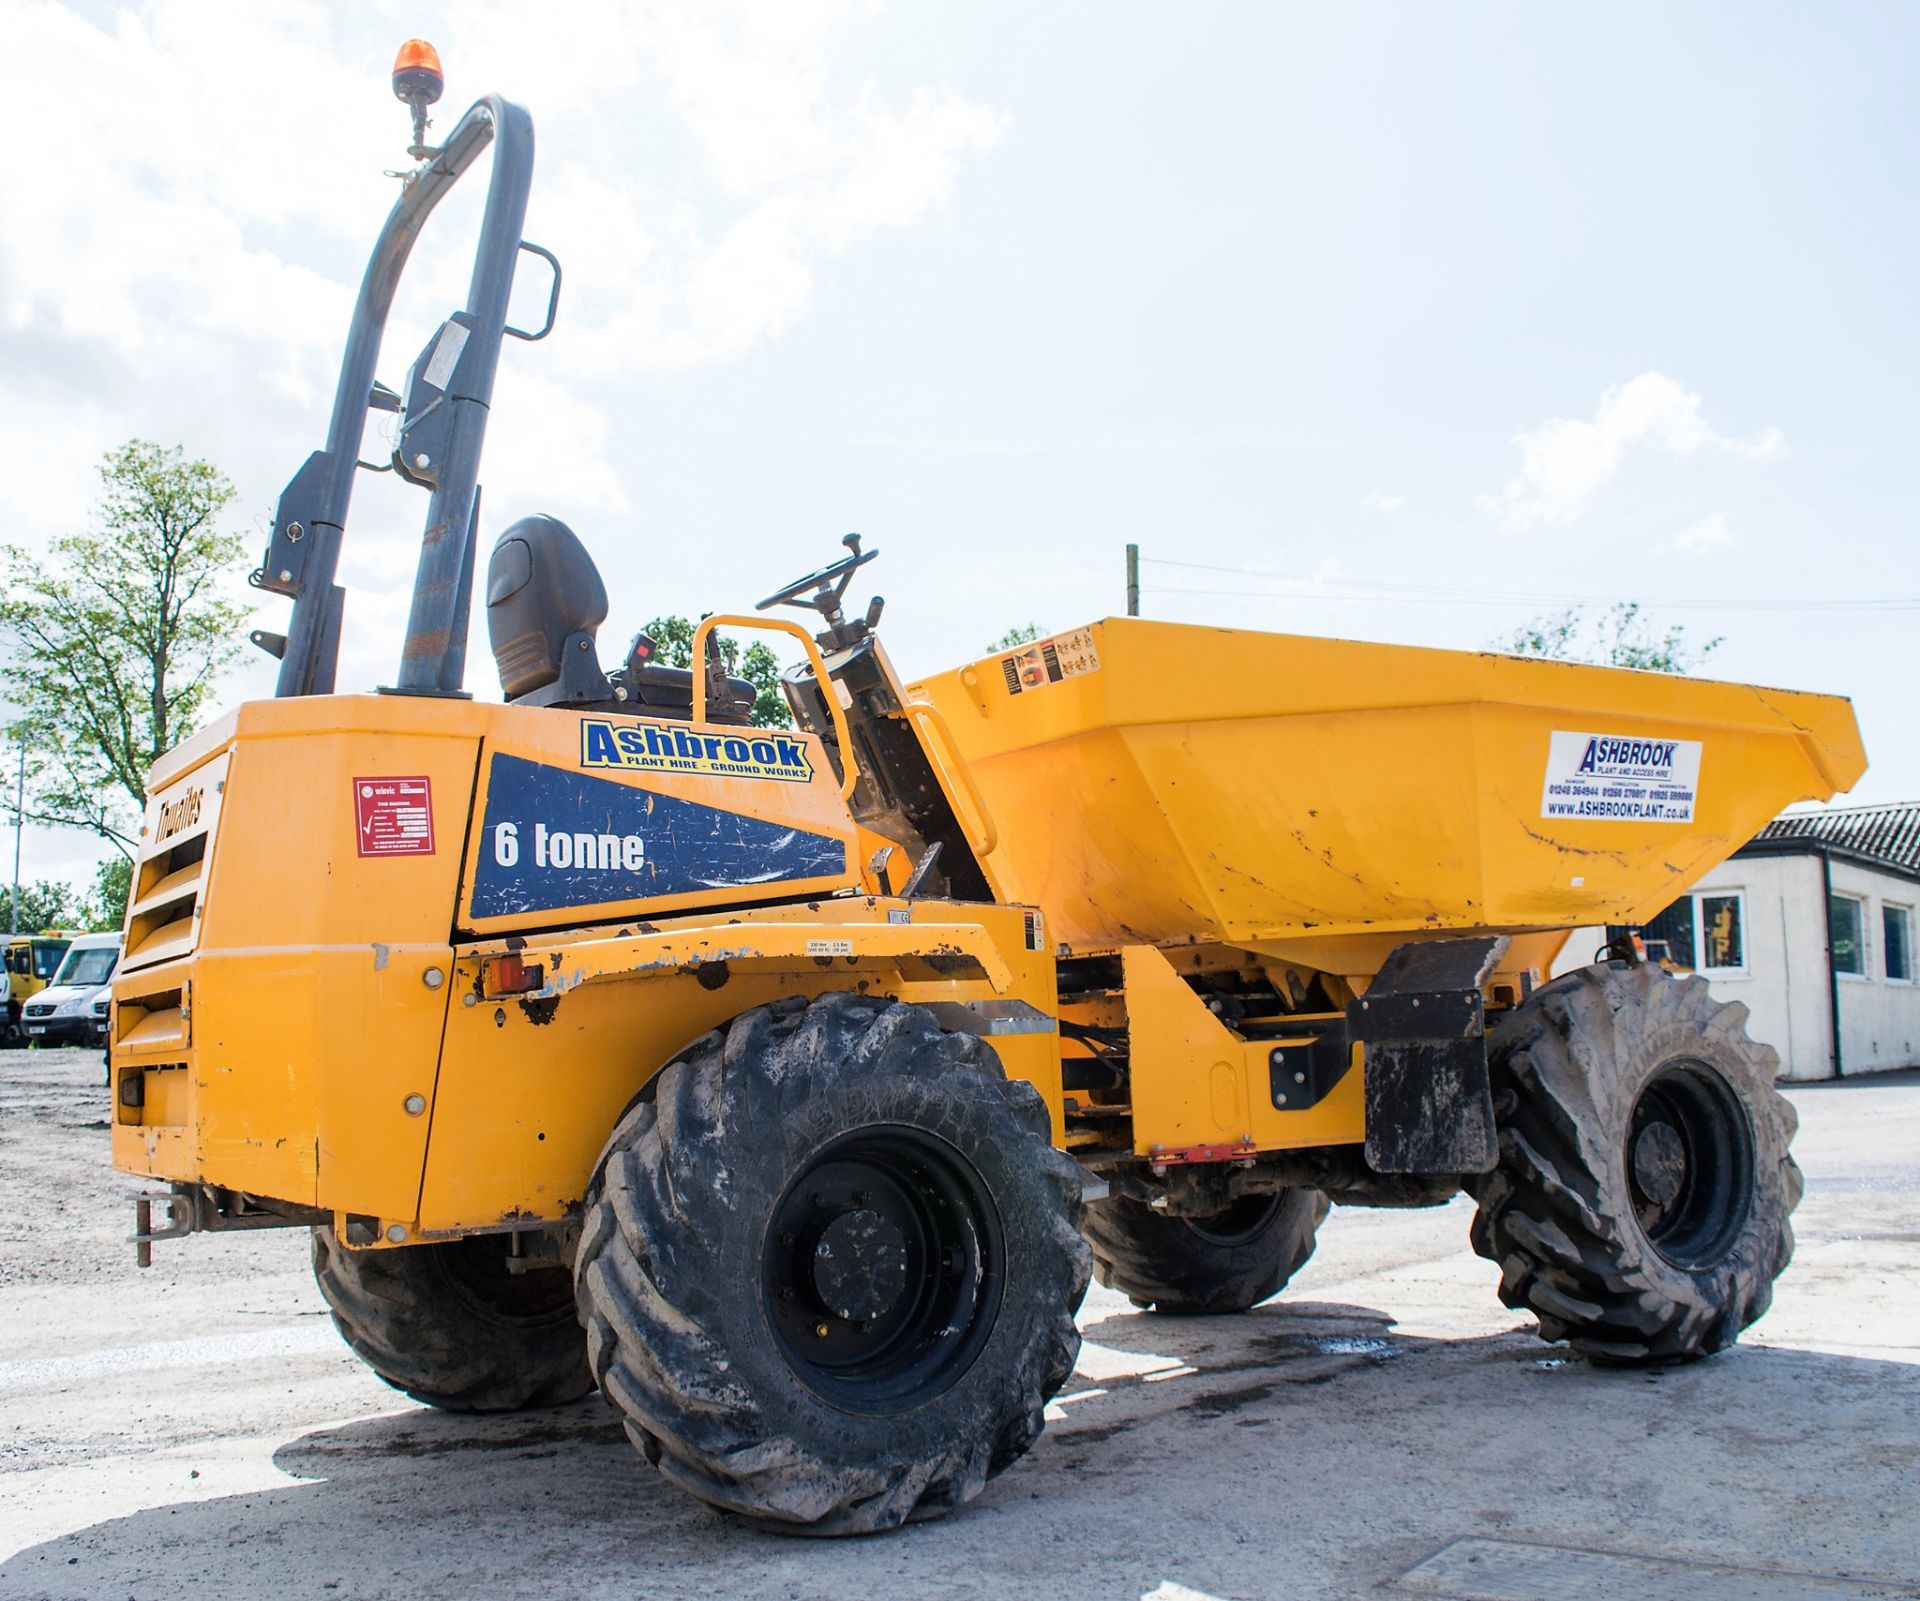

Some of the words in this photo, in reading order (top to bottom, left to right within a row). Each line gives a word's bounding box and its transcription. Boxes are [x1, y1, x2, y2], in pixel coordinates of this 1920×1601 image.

[587, 723, 805, 768] Ashbrook
[1579, 738, 1677, 773] ASHBROOK
[627, 756, 666, 767] PLANT
[669, 759, 699, 770] HIRE
[711, 763, 761, 774] GROUND
[764, 766, 808, 778] WORKS
[1597, 766, 1618, 775] PLANT
[1618, 768, 1631, 776] AND
[1632, 768, 1654, 777] ACCESS
[1655, 770, 1669, 778] HIRE
[1549, 784, 1571, 795] 01248
[155, 786, 204, 845] Thwaites
[1548, 800, 1690, 819] www.ASHBROOKPLANT.co.uk
[495, 822, 519, 867] 6
[535, 823, 645, 871] tonne
